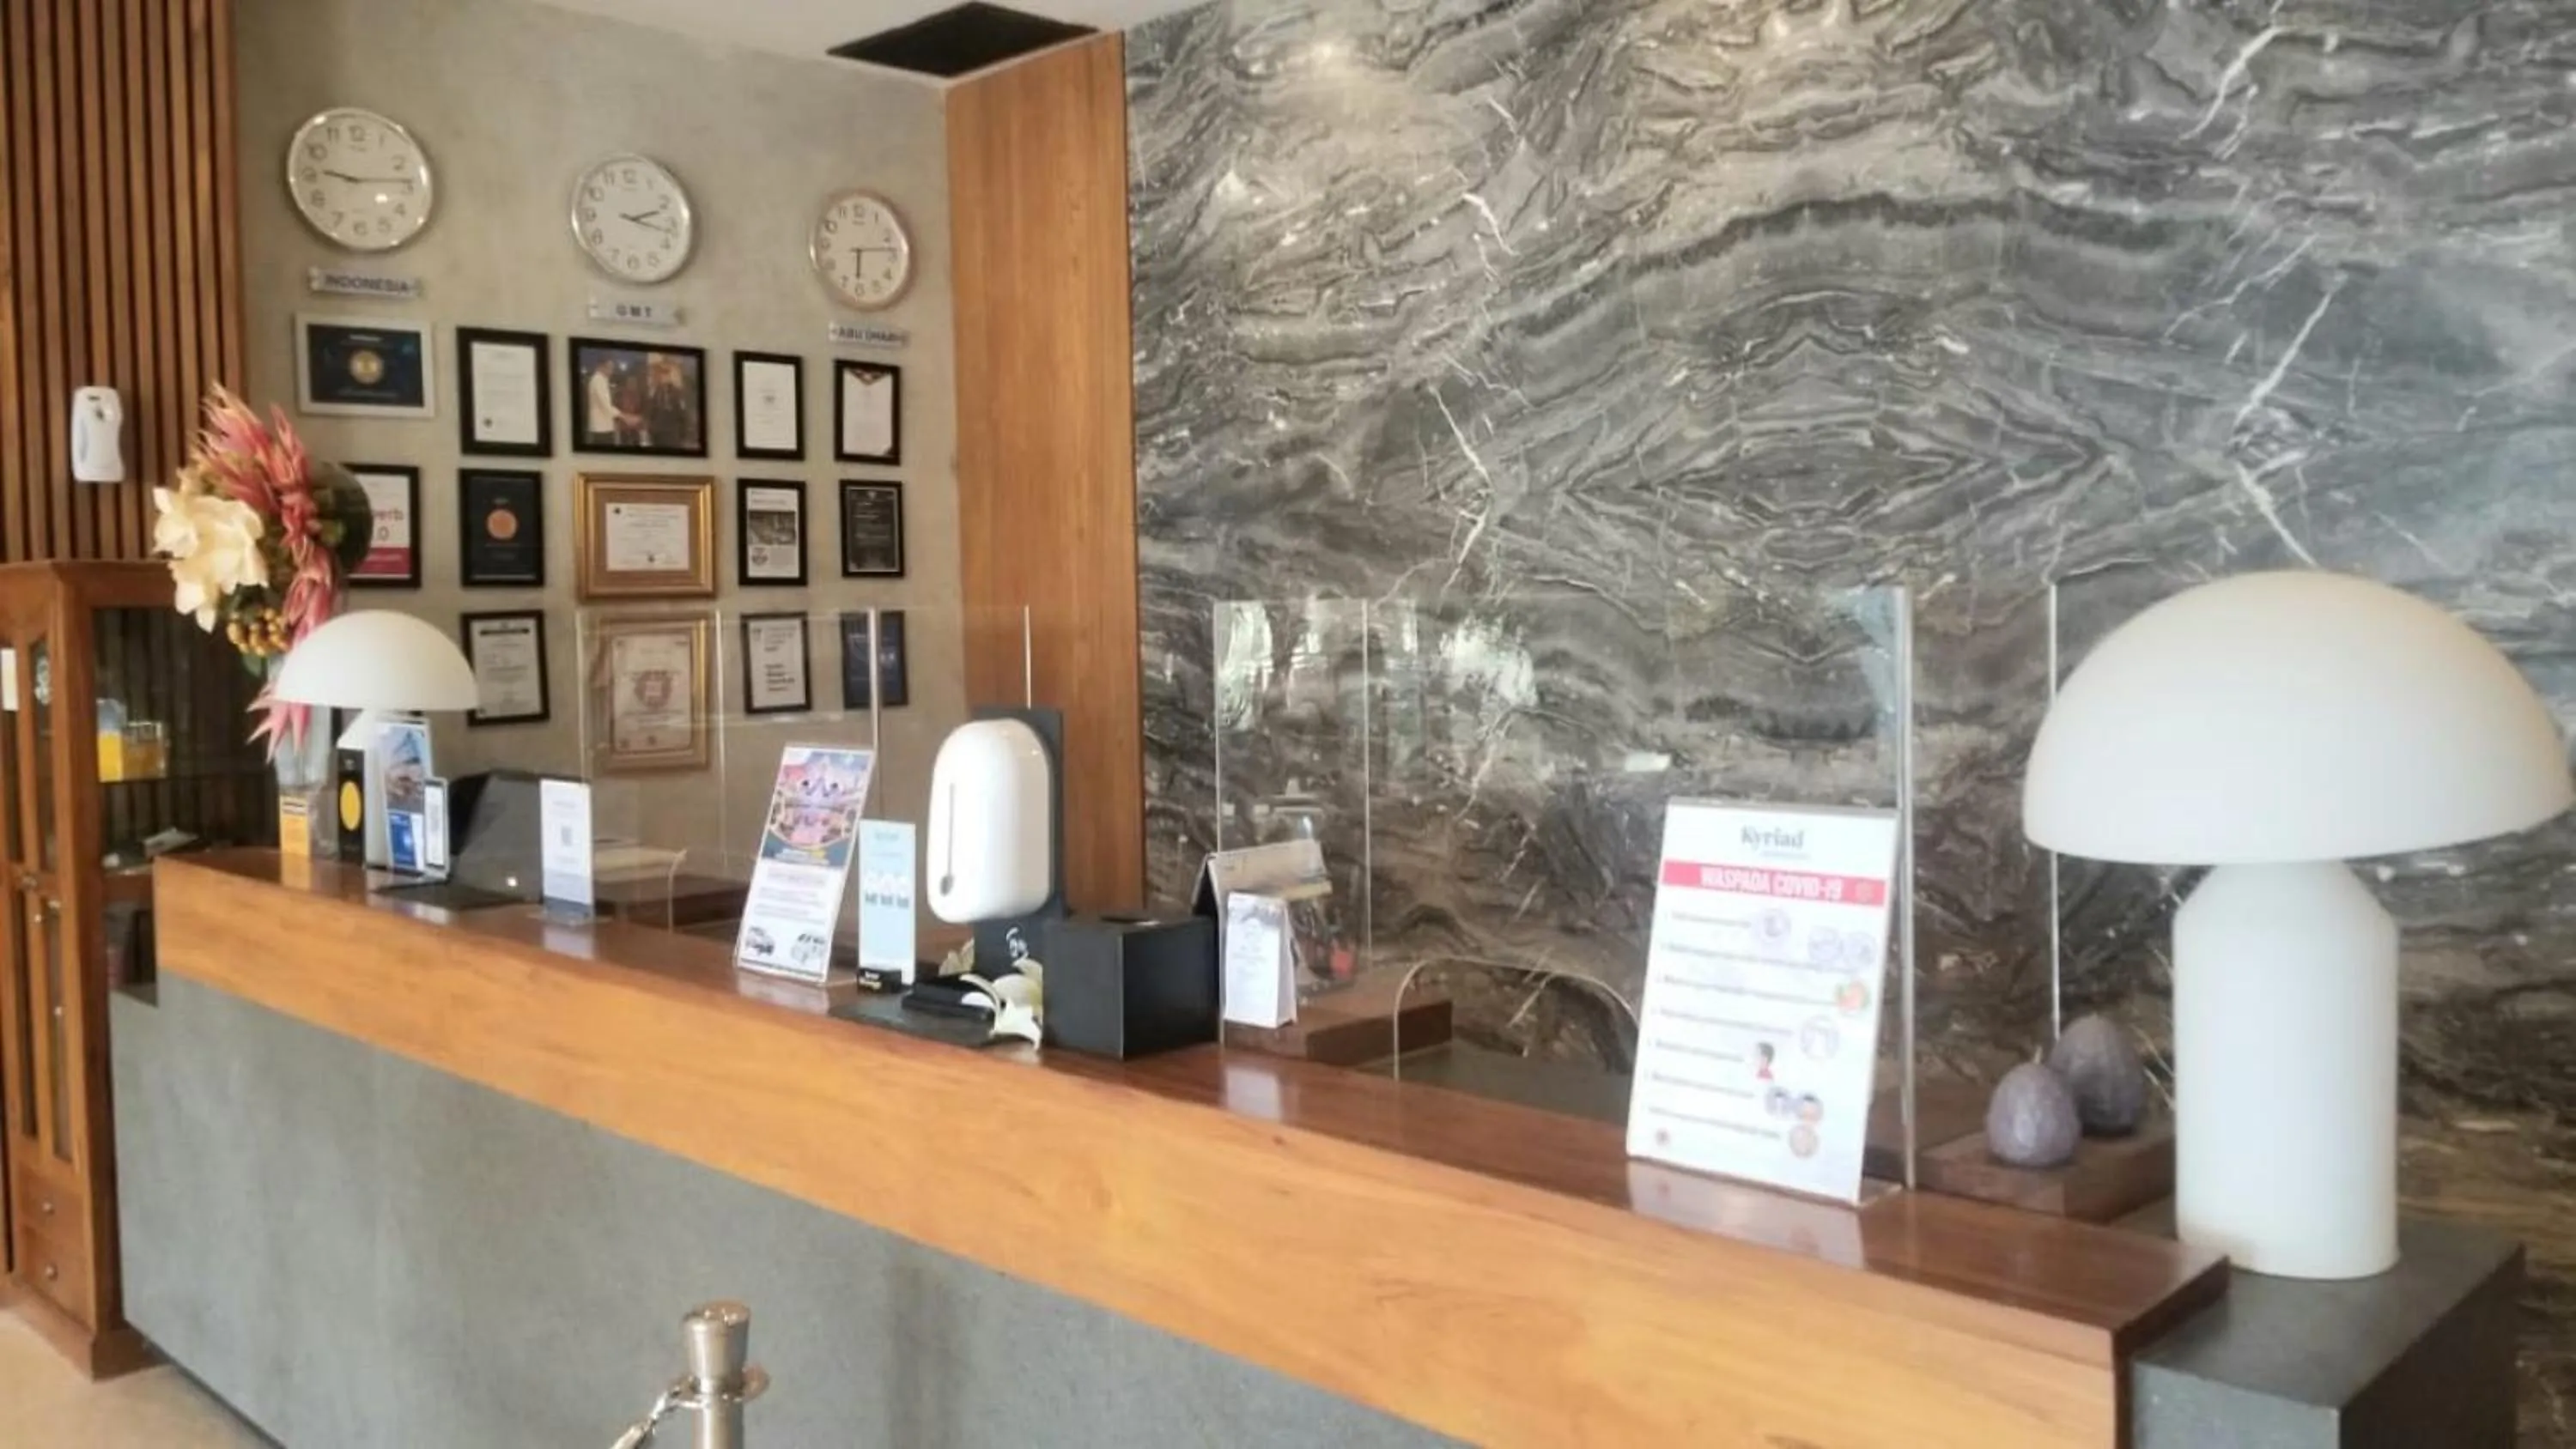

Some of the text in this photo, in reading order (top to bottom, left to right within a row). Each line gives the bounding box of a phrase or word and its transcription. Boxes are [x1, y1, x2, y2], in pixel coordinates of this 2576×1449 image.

[325, 273, 409, 293] INDONESIA
[616, 304, 652, 318] GMT
[1741, 824, 1805, 850] Kyriad
[1700, 864, 1844, 901] WASPADA COVID-19
